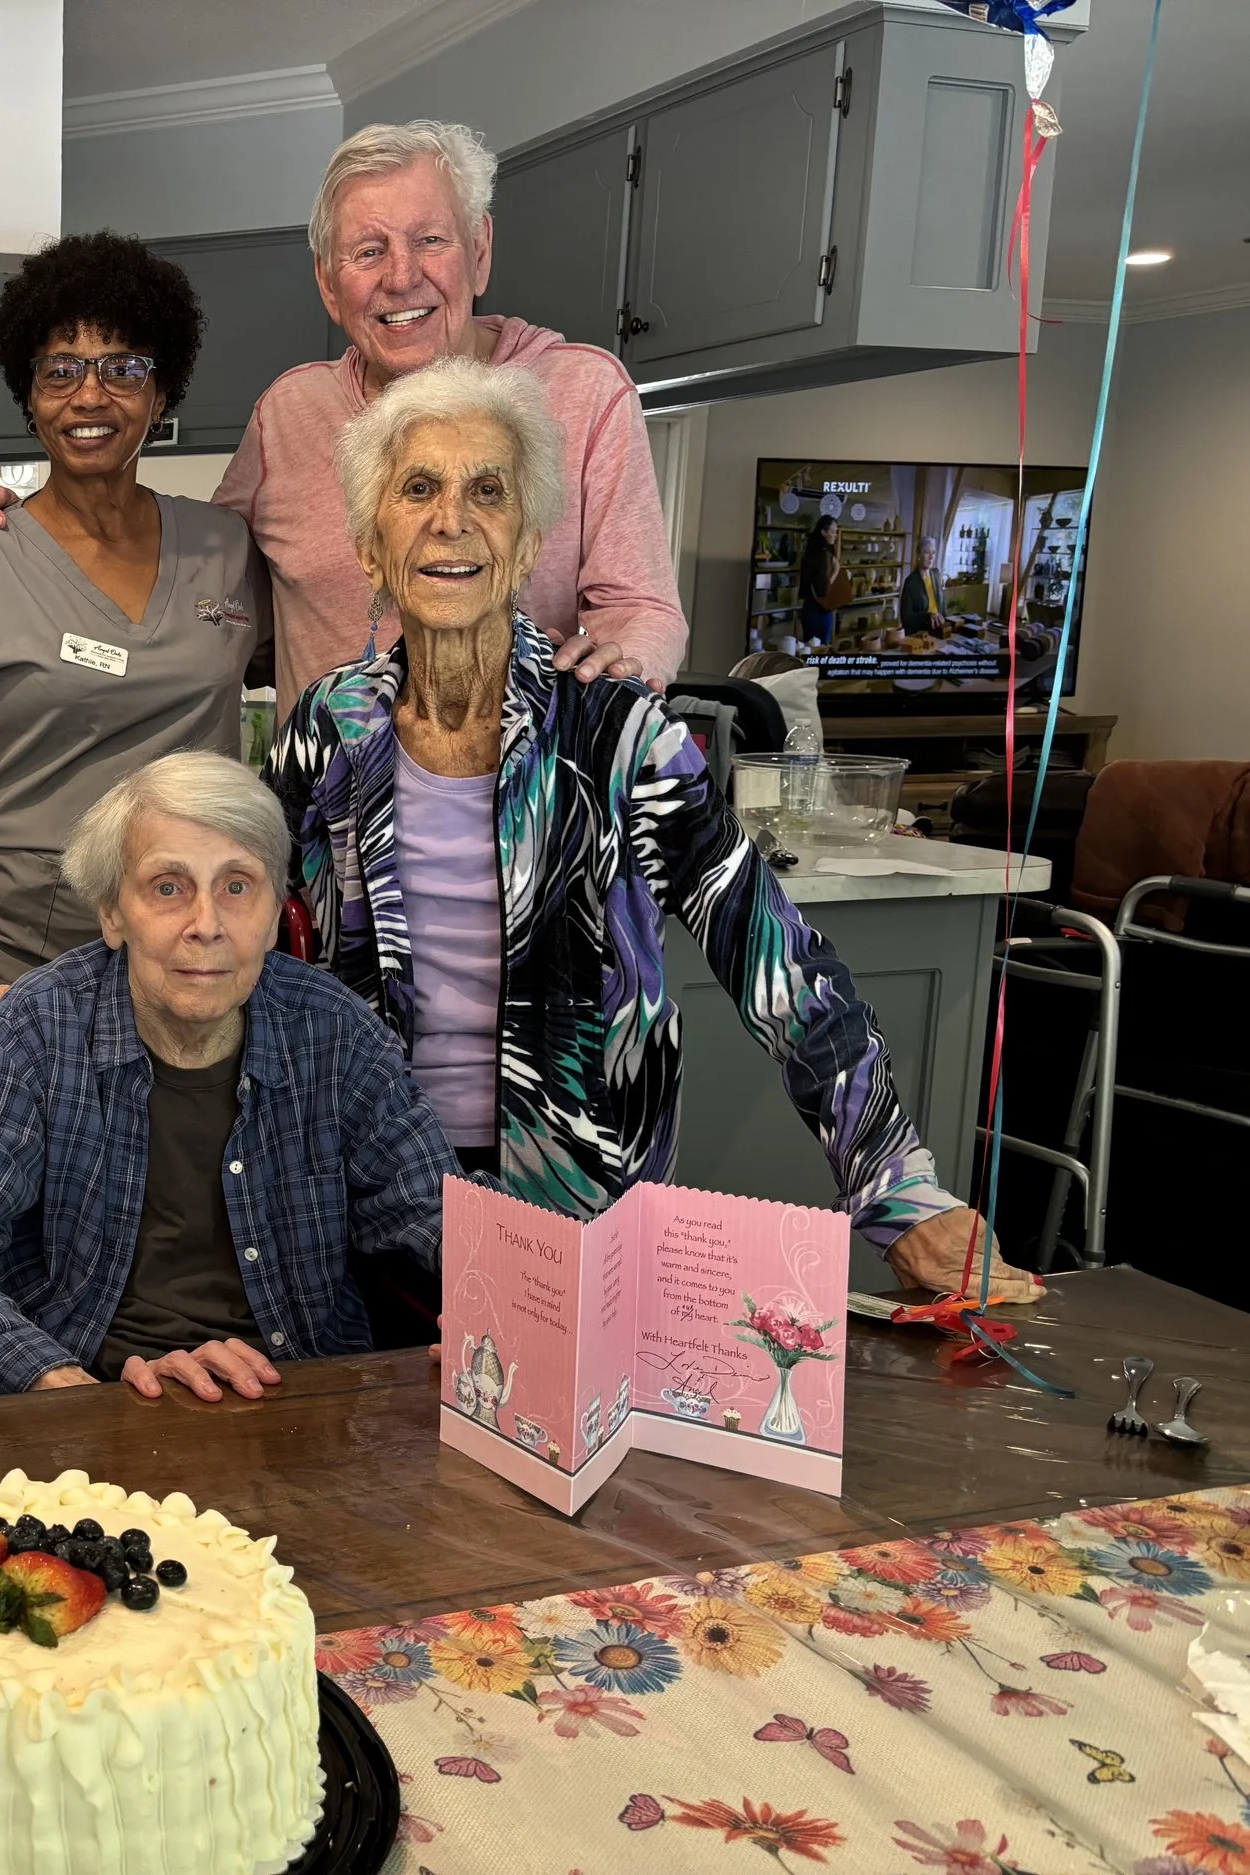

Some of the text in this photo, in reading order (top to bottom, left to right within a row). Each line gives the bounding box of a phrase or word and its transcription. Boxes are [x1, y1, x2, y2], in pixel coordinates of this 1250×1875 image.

[823, 482, 869, 493] REXULTI
[74, 655, 98, 667] Kathie,
[99, 662, 111, 670] RN
[806, 656, 878, 665] risk of death or stroke.
[827, 668, 850, 677] agitation
[850, 668, 862, 676] that
[862, 668, 874, 677] may
[874, 668, 894, 677] happen
[672, 1216, 723, 1230] As you read
[496, 1223, 562, 1264] THANK YOU
[664, 1227, 679, 1238] this
[680, 1232, 708, 1244] "thank
[656, 1242, 738, 1264] please know that it's
[520, 1271, 532, 1284] The
[661, 1260, 733, 1280] warm and sincere,
[657, 1274, 736, 1297] and it comes to you
[527, 1288, 541, 1304] have
[540, 1296, 546, 1307] in
[546, 1299, 561, 1312] mind
[663, 1288, 729, 1310] from the bottom
[512, 1299, 573, 1336] is not only for today...
[670, 1306, 680, 1316] of
[694, 1309, 719, 1324] heart.
[641, 1330, 748, 1360] With Heartfelt Thanks
